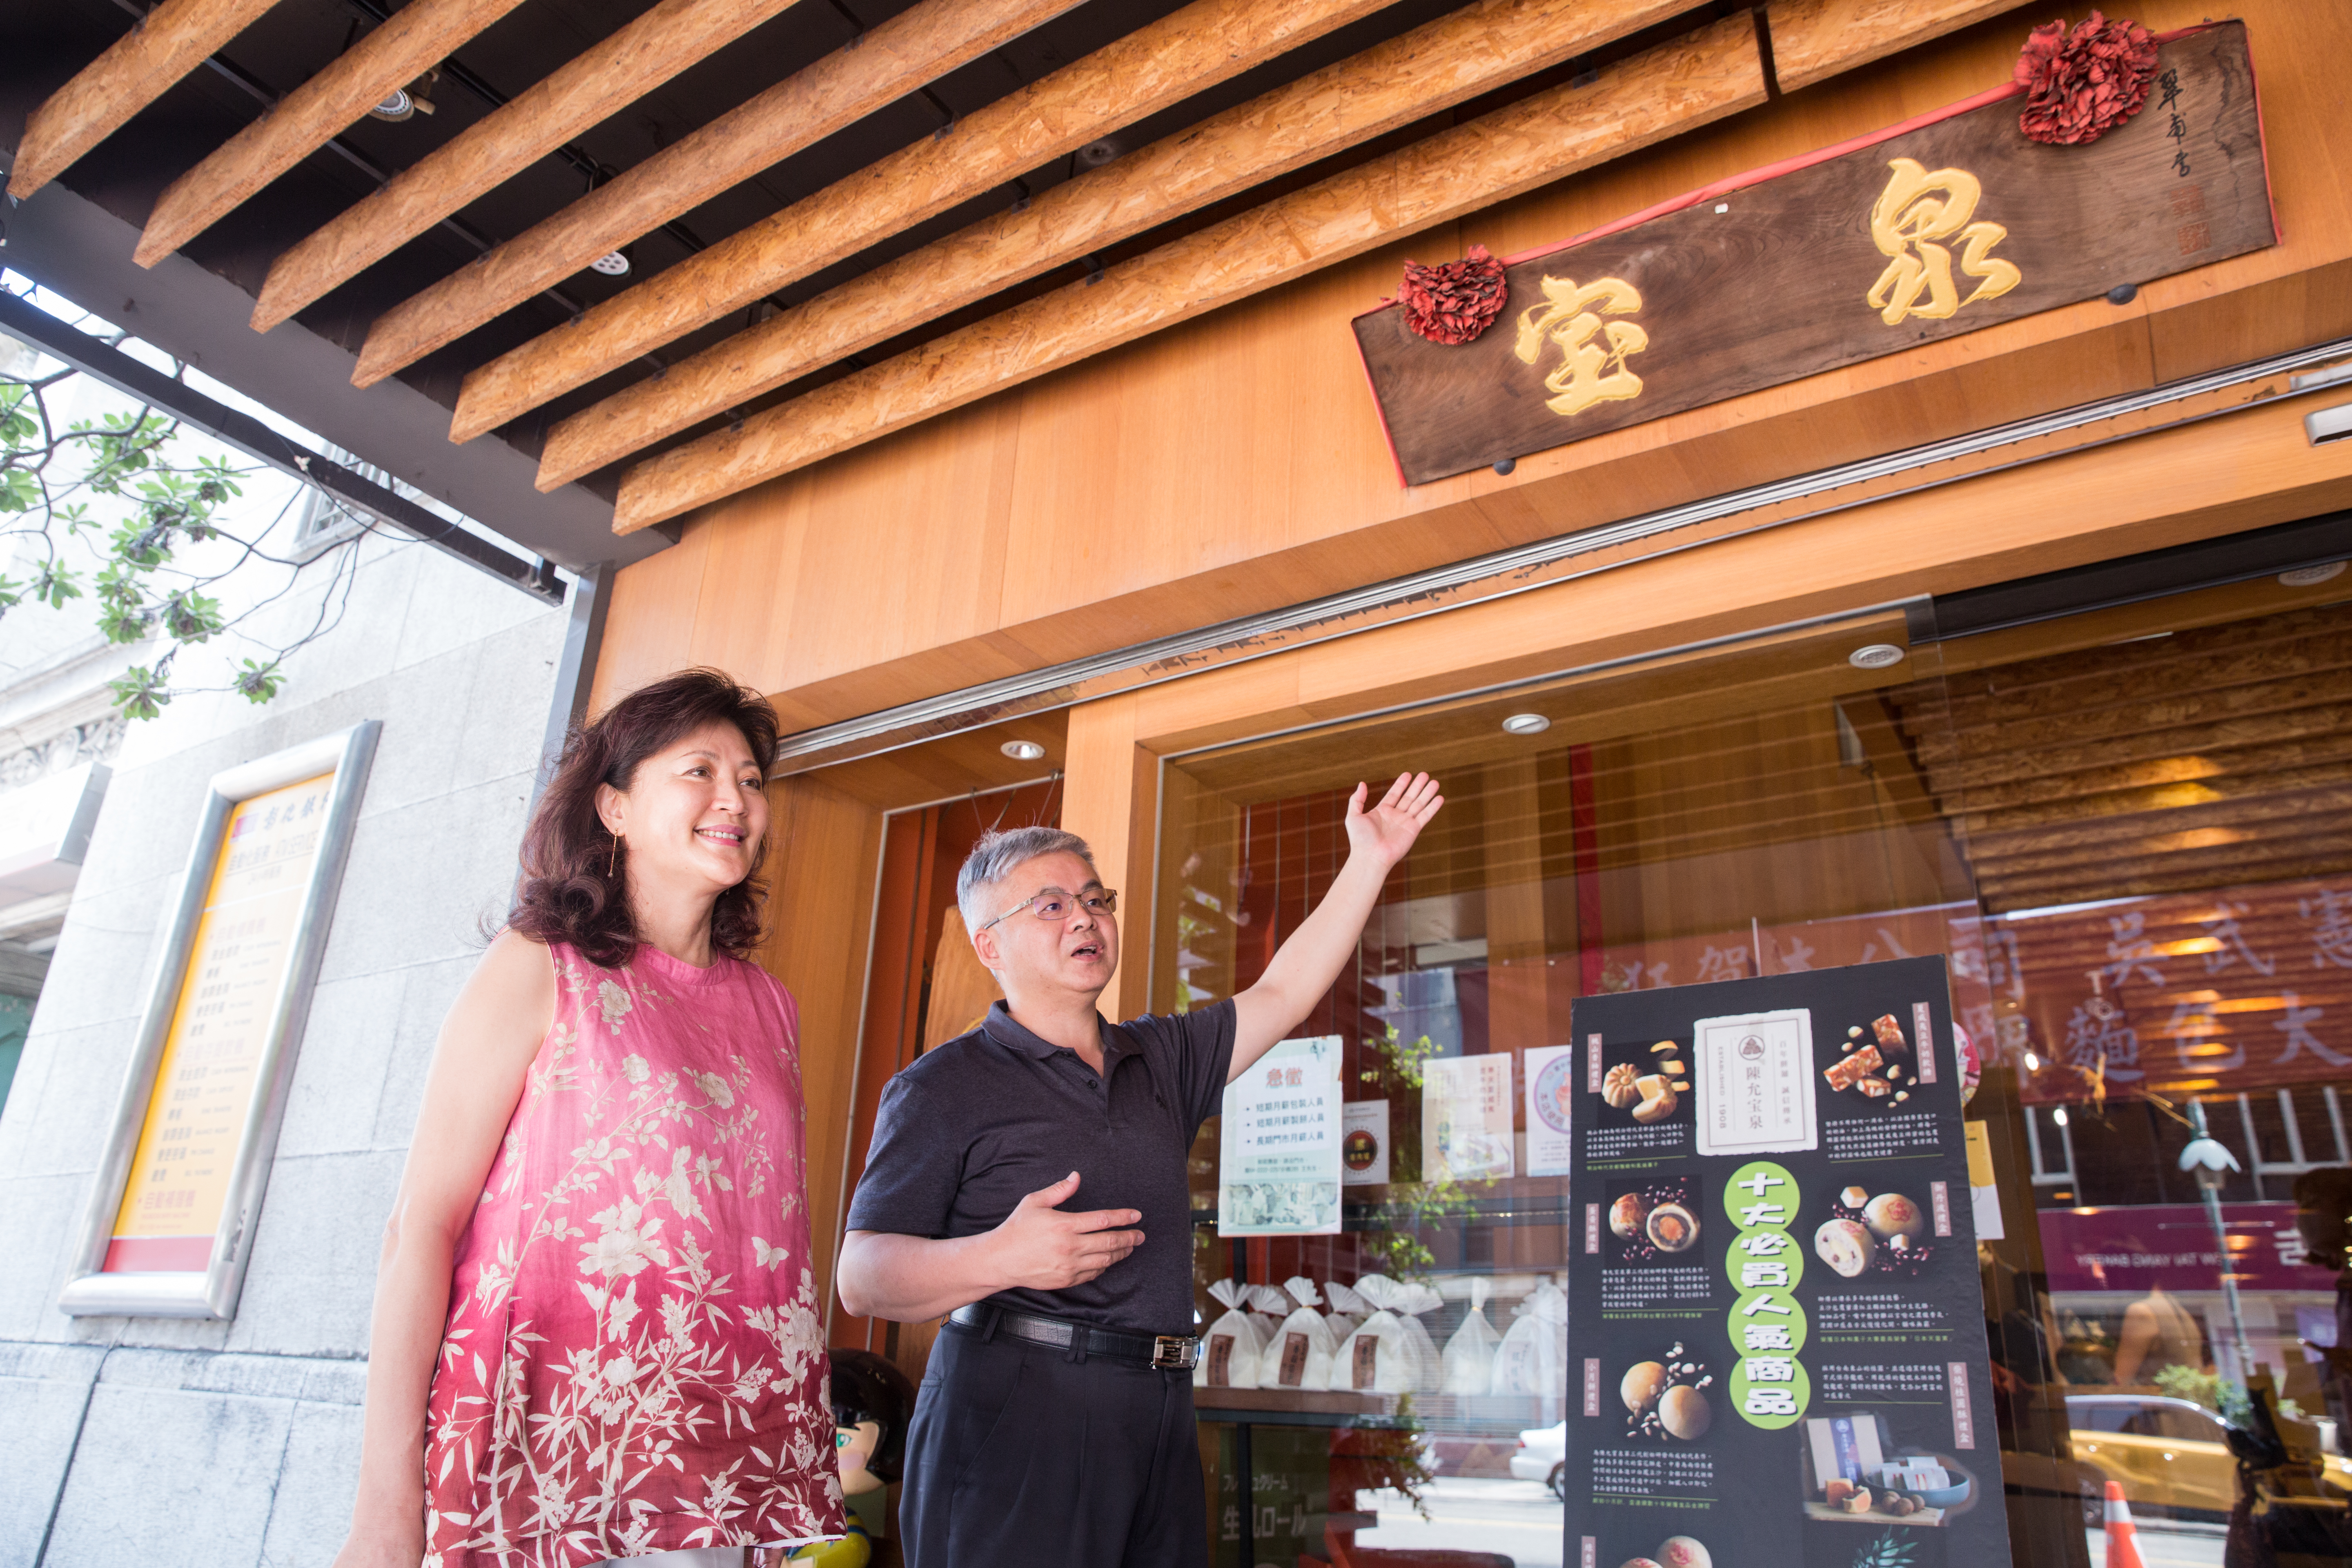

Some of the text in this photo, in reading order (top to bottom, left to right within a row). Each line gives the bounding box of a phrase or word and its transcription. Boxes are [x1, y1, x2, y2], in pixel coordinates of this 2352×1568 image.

[1266, 1066, 1303, 1088] 急徵
[1719, 1103, 1727, 1129] 1908
[1737, 1171, 1798, 1417] 十大必買人氣商品
